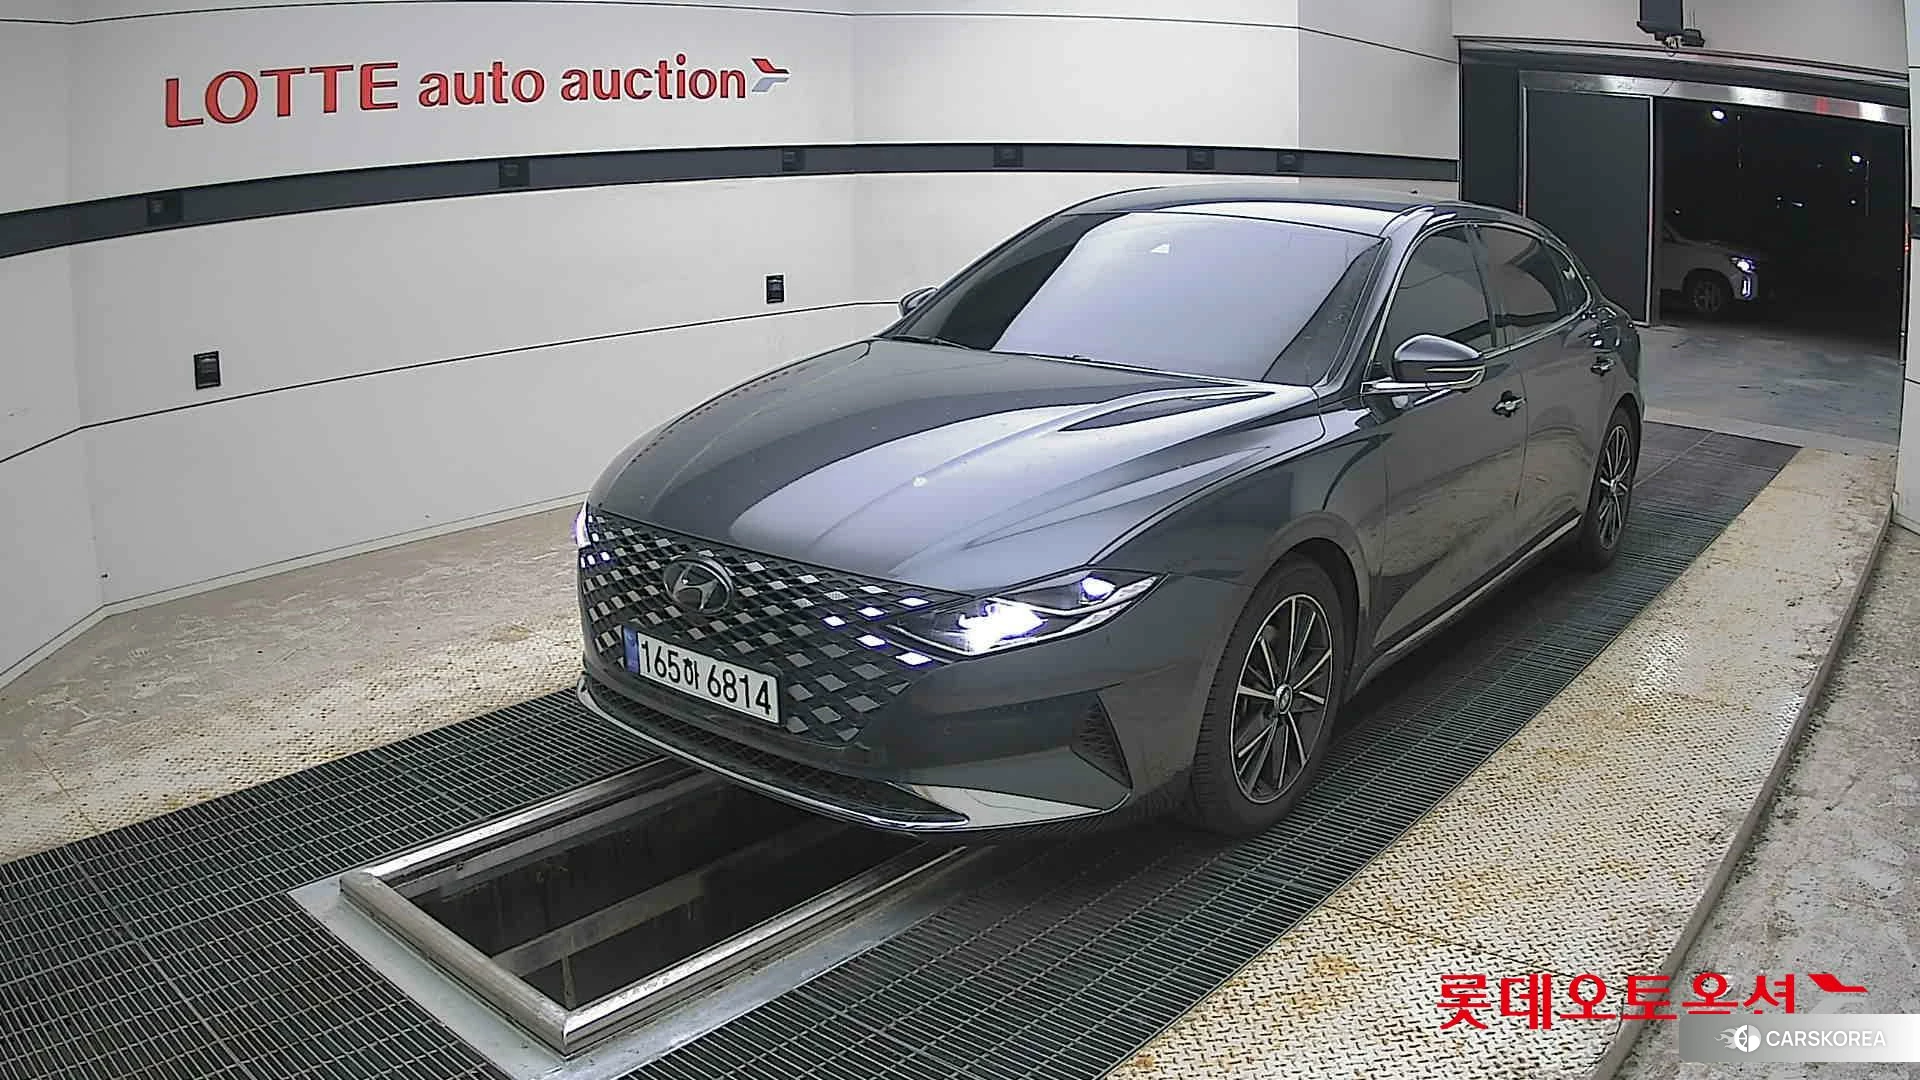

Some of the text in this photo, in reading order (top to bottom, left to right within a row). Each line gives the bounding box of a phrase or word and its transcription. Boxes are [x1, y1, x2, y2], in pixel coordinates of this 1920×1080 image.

[165, 53, 747, 128] LOTTE auto auction
[641, 640, 772, 716] 165하 6814
